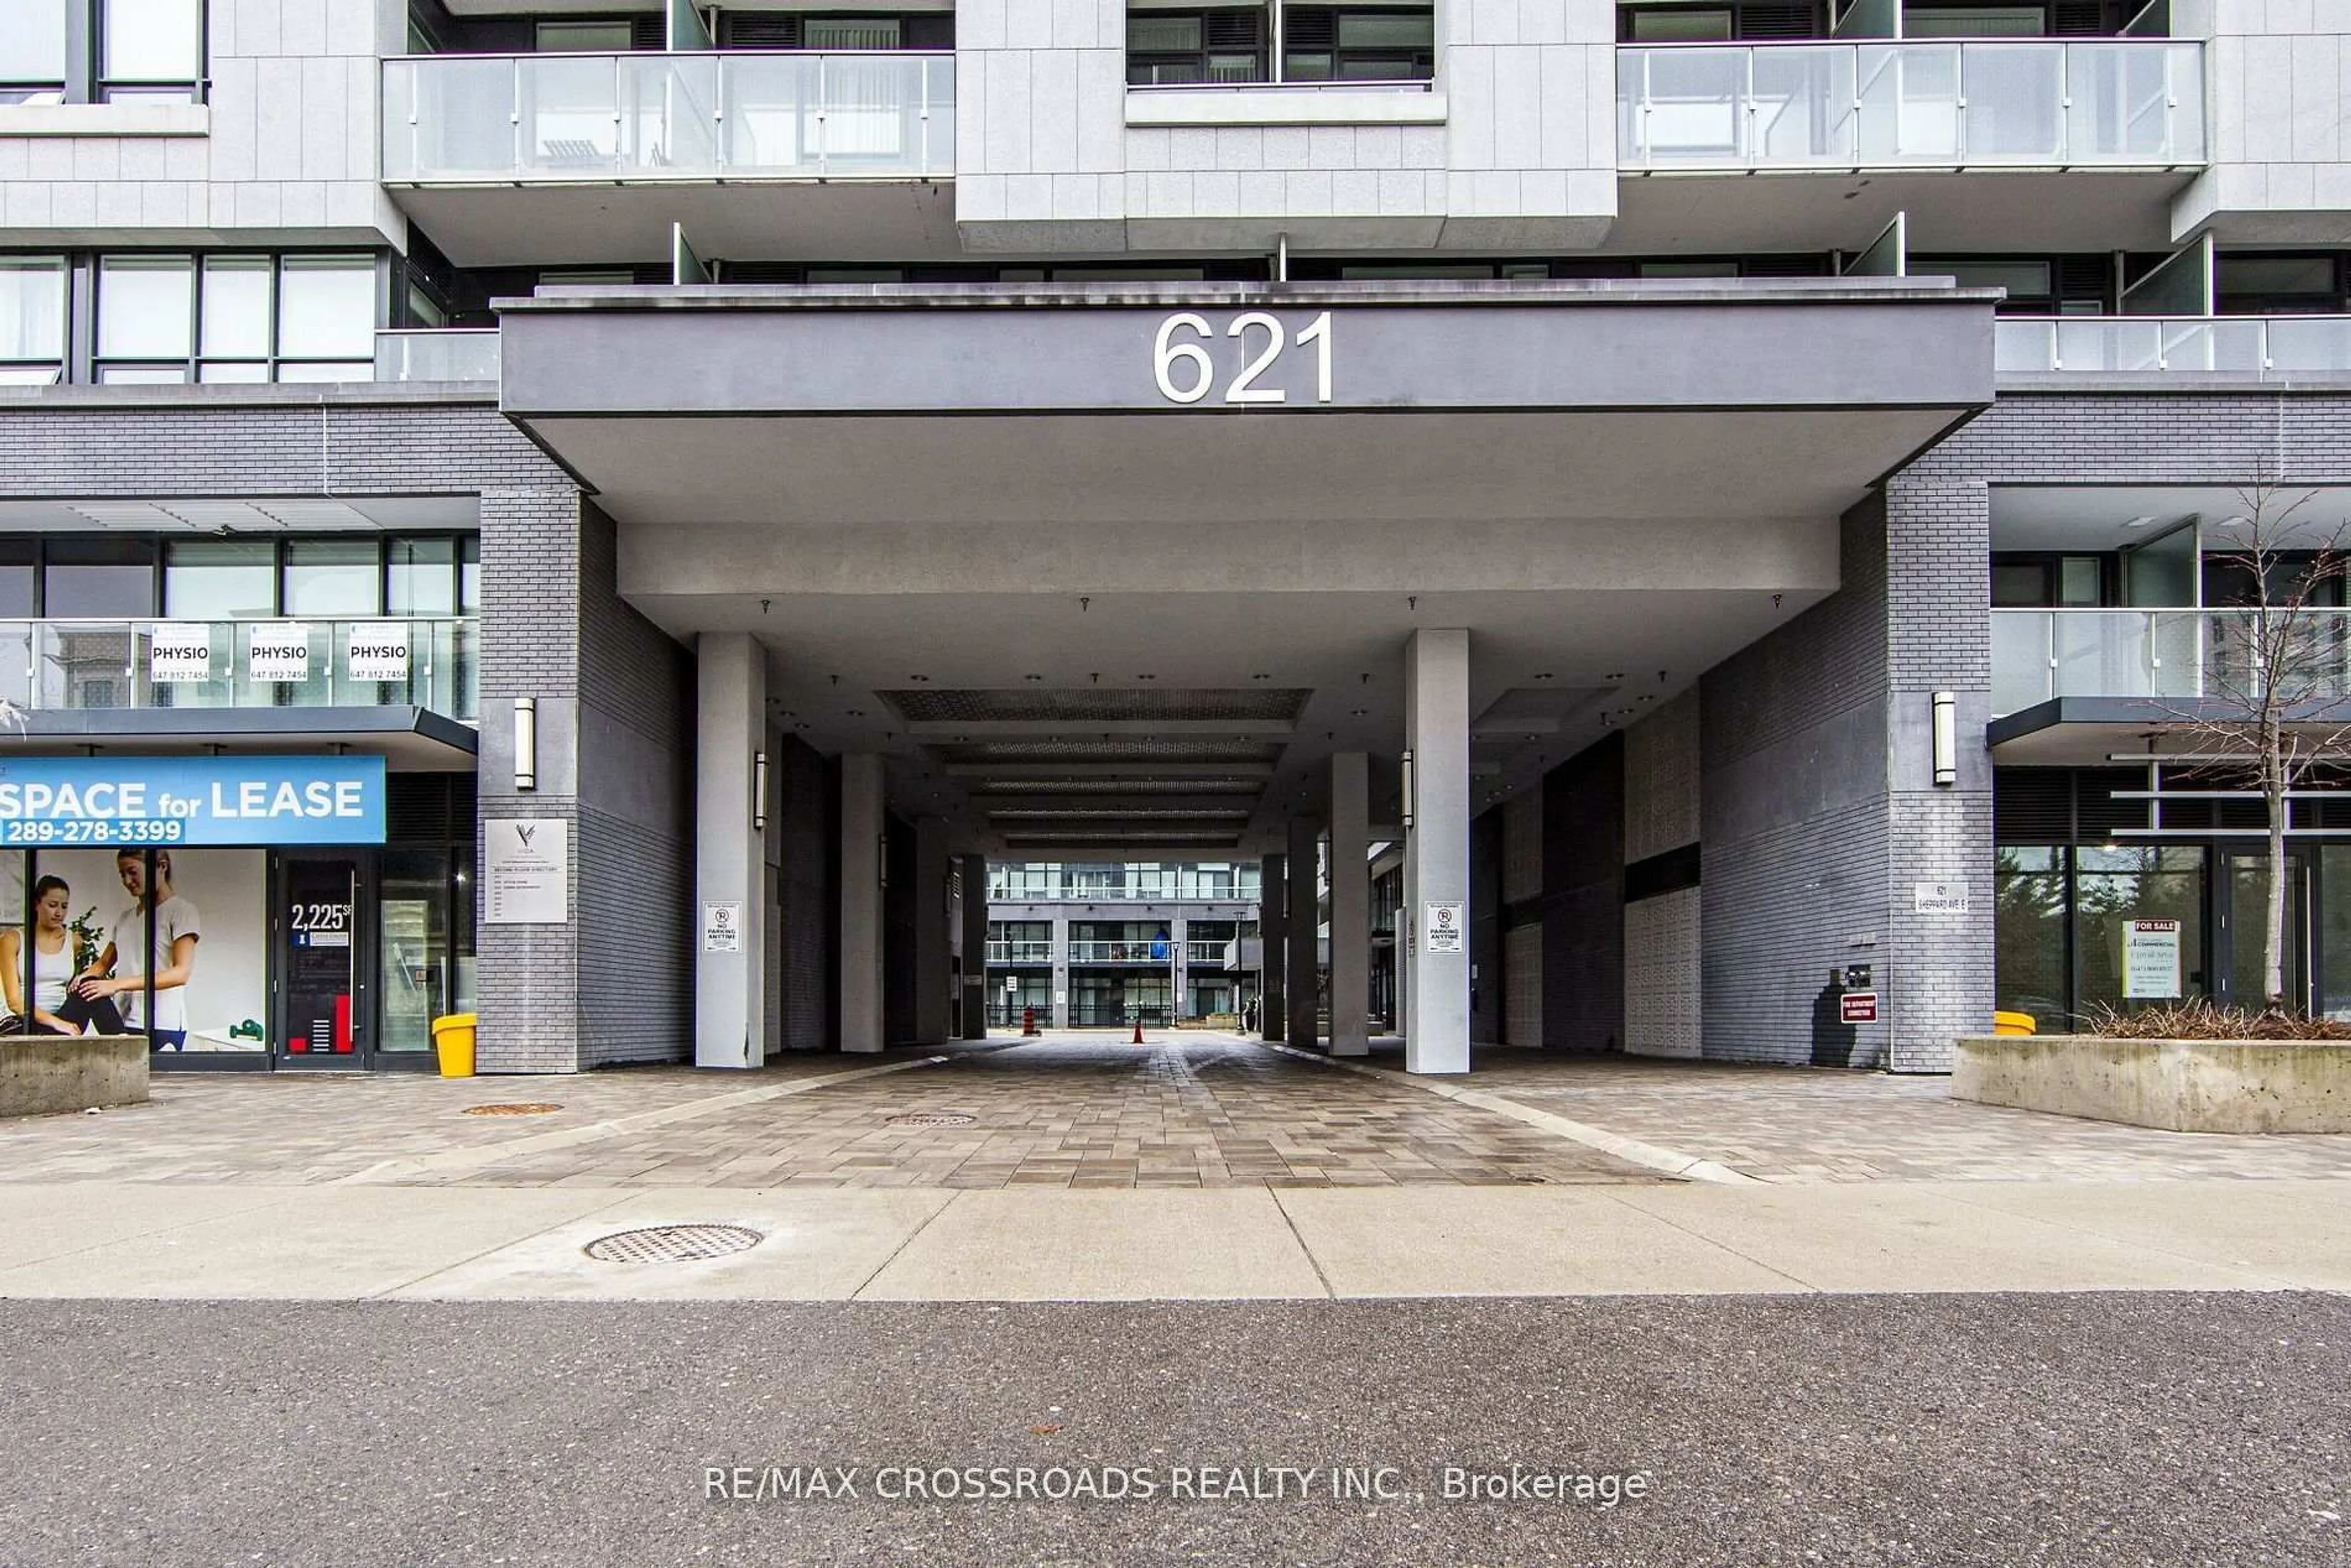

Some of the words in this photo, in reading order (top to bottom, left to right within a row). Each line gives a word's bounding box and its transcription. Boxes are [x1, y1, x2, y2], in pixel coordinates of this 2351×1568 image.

[1154, 312, 1332, 403] 621
[154, 647, 208, 659] PHYSIO
[252, 647, 306, 659] PHYSIO
[351, 646, 407, 658] PHYSIO
[0, 782, 146, 819] SPACE
[159, 793, 201, 818] for
[211, 781, 364, 818] LEASE
[7, 820, 181, 842] 289-278-3399
